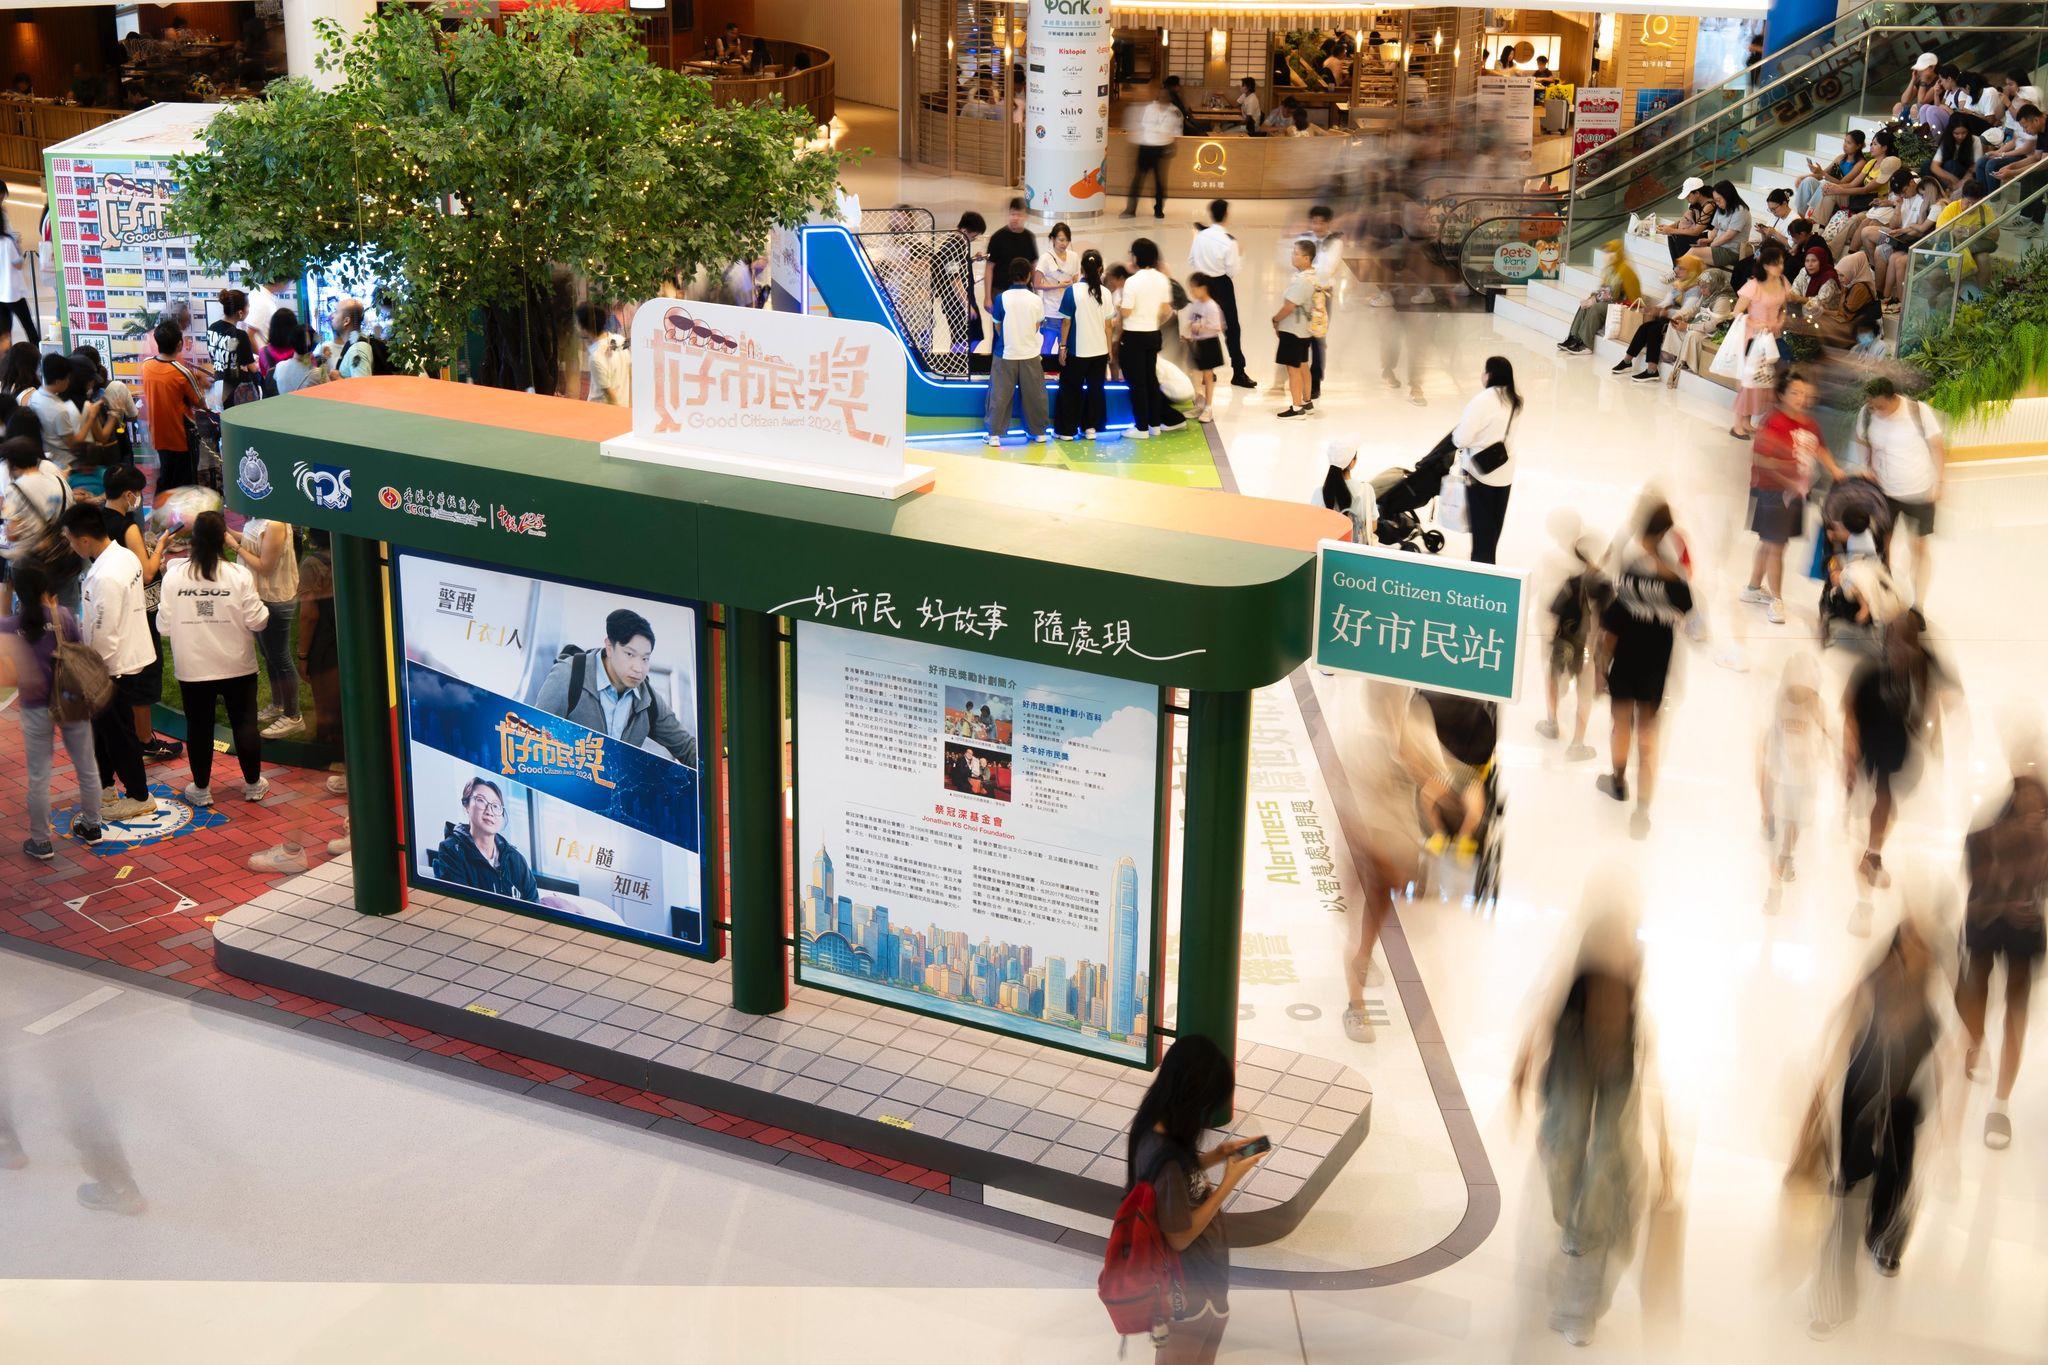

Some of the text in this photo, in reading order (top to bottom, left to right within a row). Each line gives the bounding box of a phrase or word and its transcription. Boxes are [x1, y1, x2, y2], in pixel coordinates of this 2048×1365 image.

[1045, 0, 1091, 15] Park
[123, 231, 157, 244] Good
[645, 328, 890, 448] 好市民獎
[688, 412, 842, 434] Good Citizen Award 2024
[177, 588, 231, 597] HKSOS
[438, 587, 475, 614] 警醒
[1333, 571, 1507, 614] Good Citizen Station
[804, 584, 1150, 659] 好市民 好故事 隨處現
[1329, 602, 1505, 672] 好市民站
[495, 720, 617, 790] 好市民獎
[517, 763, 543, 774] Good
[575, 769, 593, 781] 2024
[921, 814, 951, 827] Jonathan
[963, 823, 977, 832] Choi
[979, 826, 1014, 840] Foundation
[935, 803, 1002, 827] 蔡冠深基金會
[1257, 800, 1301, 885] Alertness
[1290, 798, 1348, 913] 以智慧處理問題
[614, 875, 651, 901] 知味
